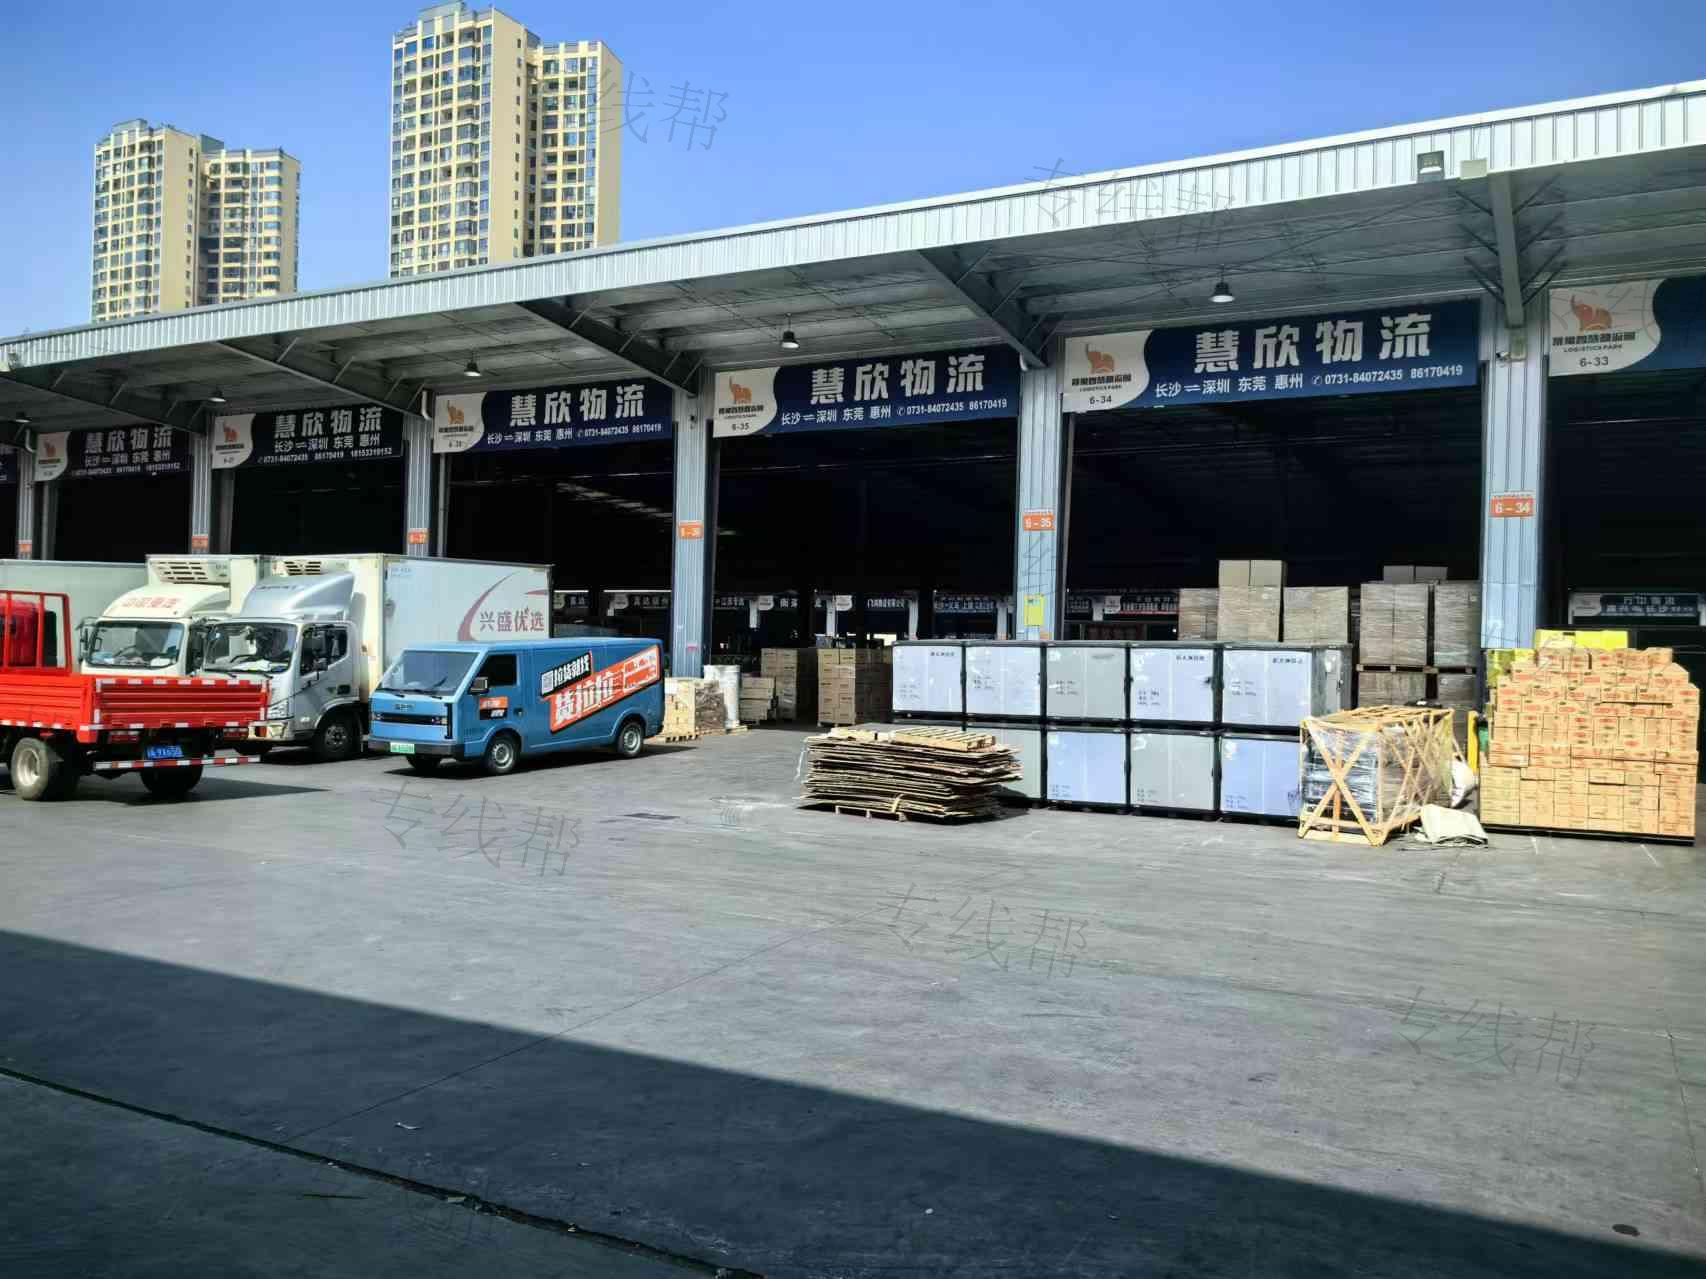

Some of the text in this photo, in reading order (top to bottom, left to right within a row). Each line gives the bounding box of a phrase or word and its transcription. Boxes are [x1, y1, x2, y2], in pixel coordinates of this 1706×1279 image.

[1194, 313, 1431, 373] 慧欣物流
[1579, 356, 1609, 367] 6-33
[810, 354, 985, 405] 慧欣物流
[1154, 383, 1182, 398] 长沙
[1201, 379, 1230, 395] 深圳
[1238, 376, 1266, 392] 东莞
[1274, 373, 1303, 390] 惠州
[510, 383, 645, 427] 慧欣物流
[1089, 394, 1113, 406] 6-34
[274, 406, 383, 439] 慧欣物流
[781, 411, 801, 426] 长沙
[816, 408, 838, 424] 深圳
[842, 406, 865, 422] 东莞
[480, 606, 545, 632] 兴盛优选
